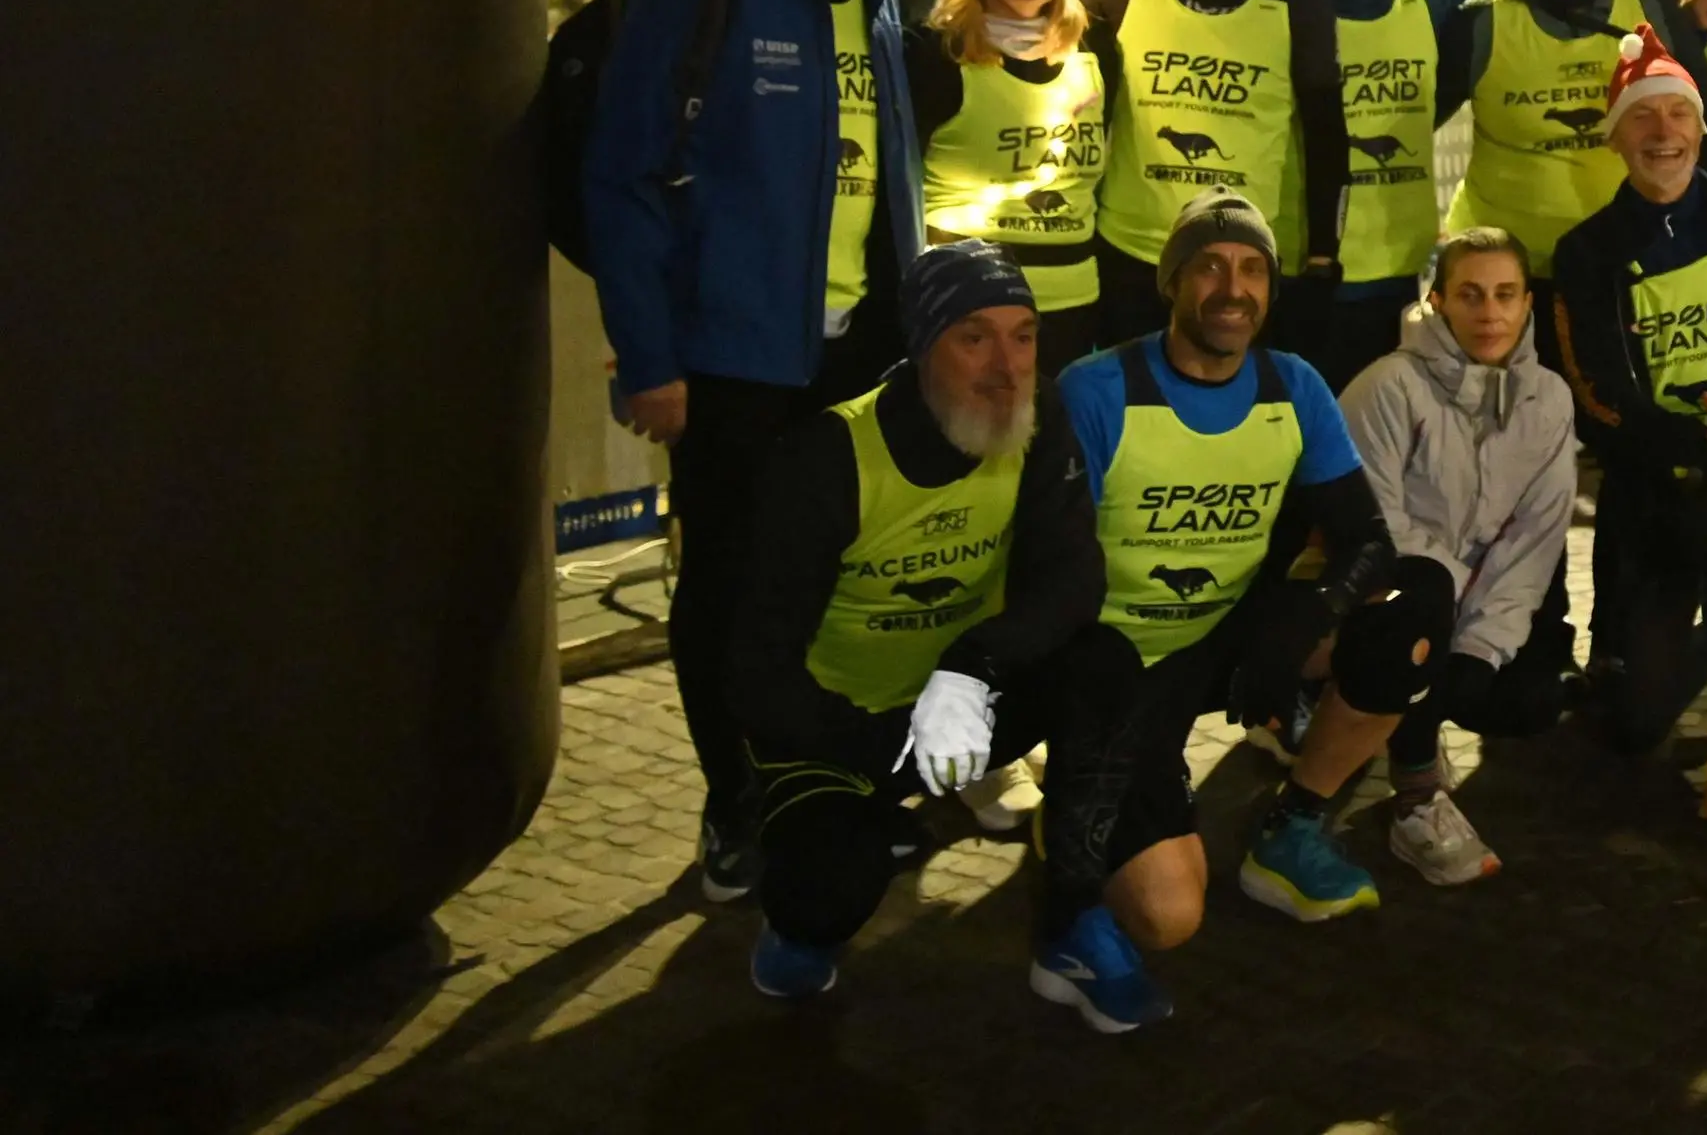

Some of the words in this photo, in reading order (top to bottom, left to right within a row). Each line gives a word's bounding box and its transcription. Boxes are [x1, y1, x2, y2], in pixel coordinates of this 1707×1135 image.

[1151, 74, 1248, 104] LAND
[1343, 80, 1419, 106] AND
[1012, 144, 1102, 174] LAND
[1145, 509, 1261, 533] LAND
[840, 534, 1000, 577] PACERUNN
[1120, 537, 1181, 548] SUPPORT
